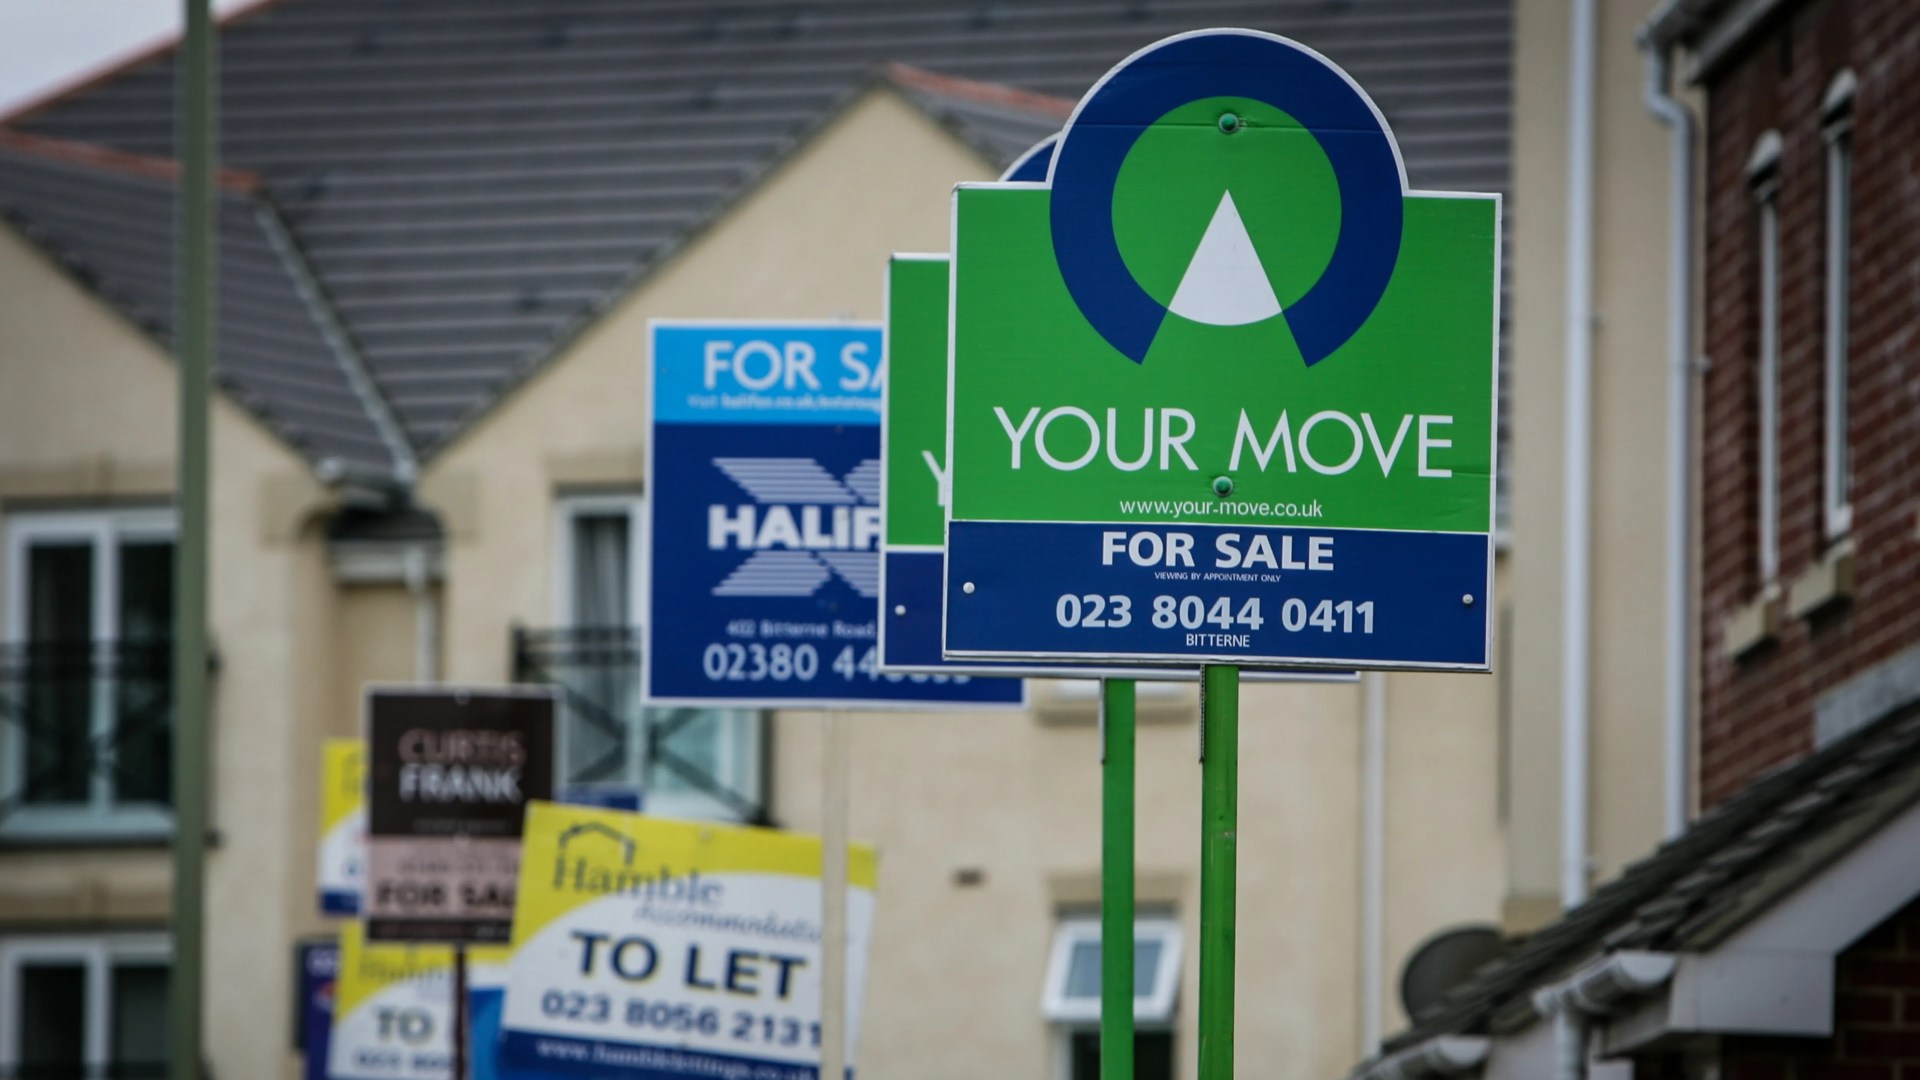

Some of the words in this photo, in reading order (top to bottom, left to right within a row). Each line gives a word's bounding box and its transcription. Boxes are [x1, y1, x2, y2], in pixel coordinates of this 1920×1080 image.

[704, 340, 820, 390] FOR
[993, 406, 1199, 471] YOUR
[1228, 407, 1453, 478] MOVE
[708, 503, 881, 550] HALIF
[1120, 499, 1322, 518] www.your-move.co.uk
[1102, 531, 1195, 567] FOR
[1215, 533, 1334, 571] SALE
[1155, 571, 1188, 580] VIEWING
[1191, 572, 1201, 580] BY
[1204, 572, 1258, 582] APPOINTMENT
[1261, 574, 1281, 582] ONLY
[760, 620, 829, 638] Bitterne
[1056, 594, 1132, 628] 023
[1152, 595, 1264, 630] 8044
[1282, 598, 1375, 634] 0411
[1186, 633, 1251, 648] BITTERNE
[703, 643, 819, 682] 02380
[399, 729, 526, 765] CURTIS
[400, 764, 523, 802] FRANK
[377, 879, 446, 906] FOR
[554, 857, 723, 904] Hamble
[570, 929, 660, 982] TO
[684, 941, 808, 1000] LET
[374, 1003, 435, 1047] TO
[542, 990, 612, 1023] 023
[624, 997, 719, 1036] 8056
